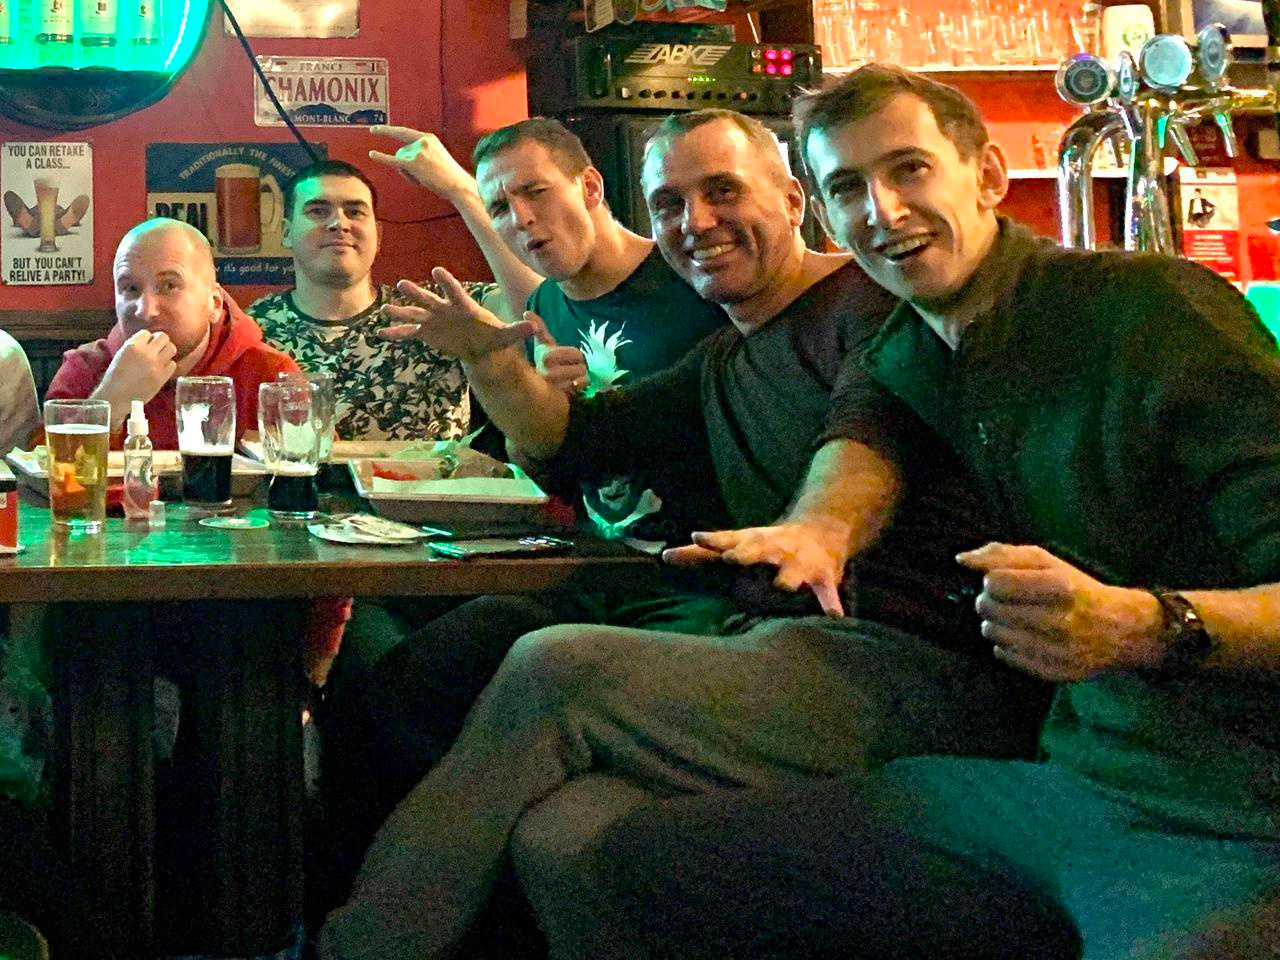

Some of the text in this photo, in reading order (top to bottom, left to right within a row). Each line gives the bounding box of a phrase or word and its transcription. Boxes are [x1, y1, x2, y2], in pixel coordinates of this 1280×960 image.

[300, 61, 343, 71] FRANCE
[265, 76, 380, 102] CHAMONIX
[295, 114, 351, 123] MONT-BLANC
[8, 145, 84, 157] YOU CAN RETAKE
[26, 158, 32, 169] A
[178, 147, 245, 180] TRADITIONALLY
[250, 148, 267, 161] THE
[13, 257, 82, 269] BUT YOU CAN'T
[239, 264, 262, 275] good
[265, 264, 279, 272] for
[10, 270, 85, 282] RELIVE A PARTY!
